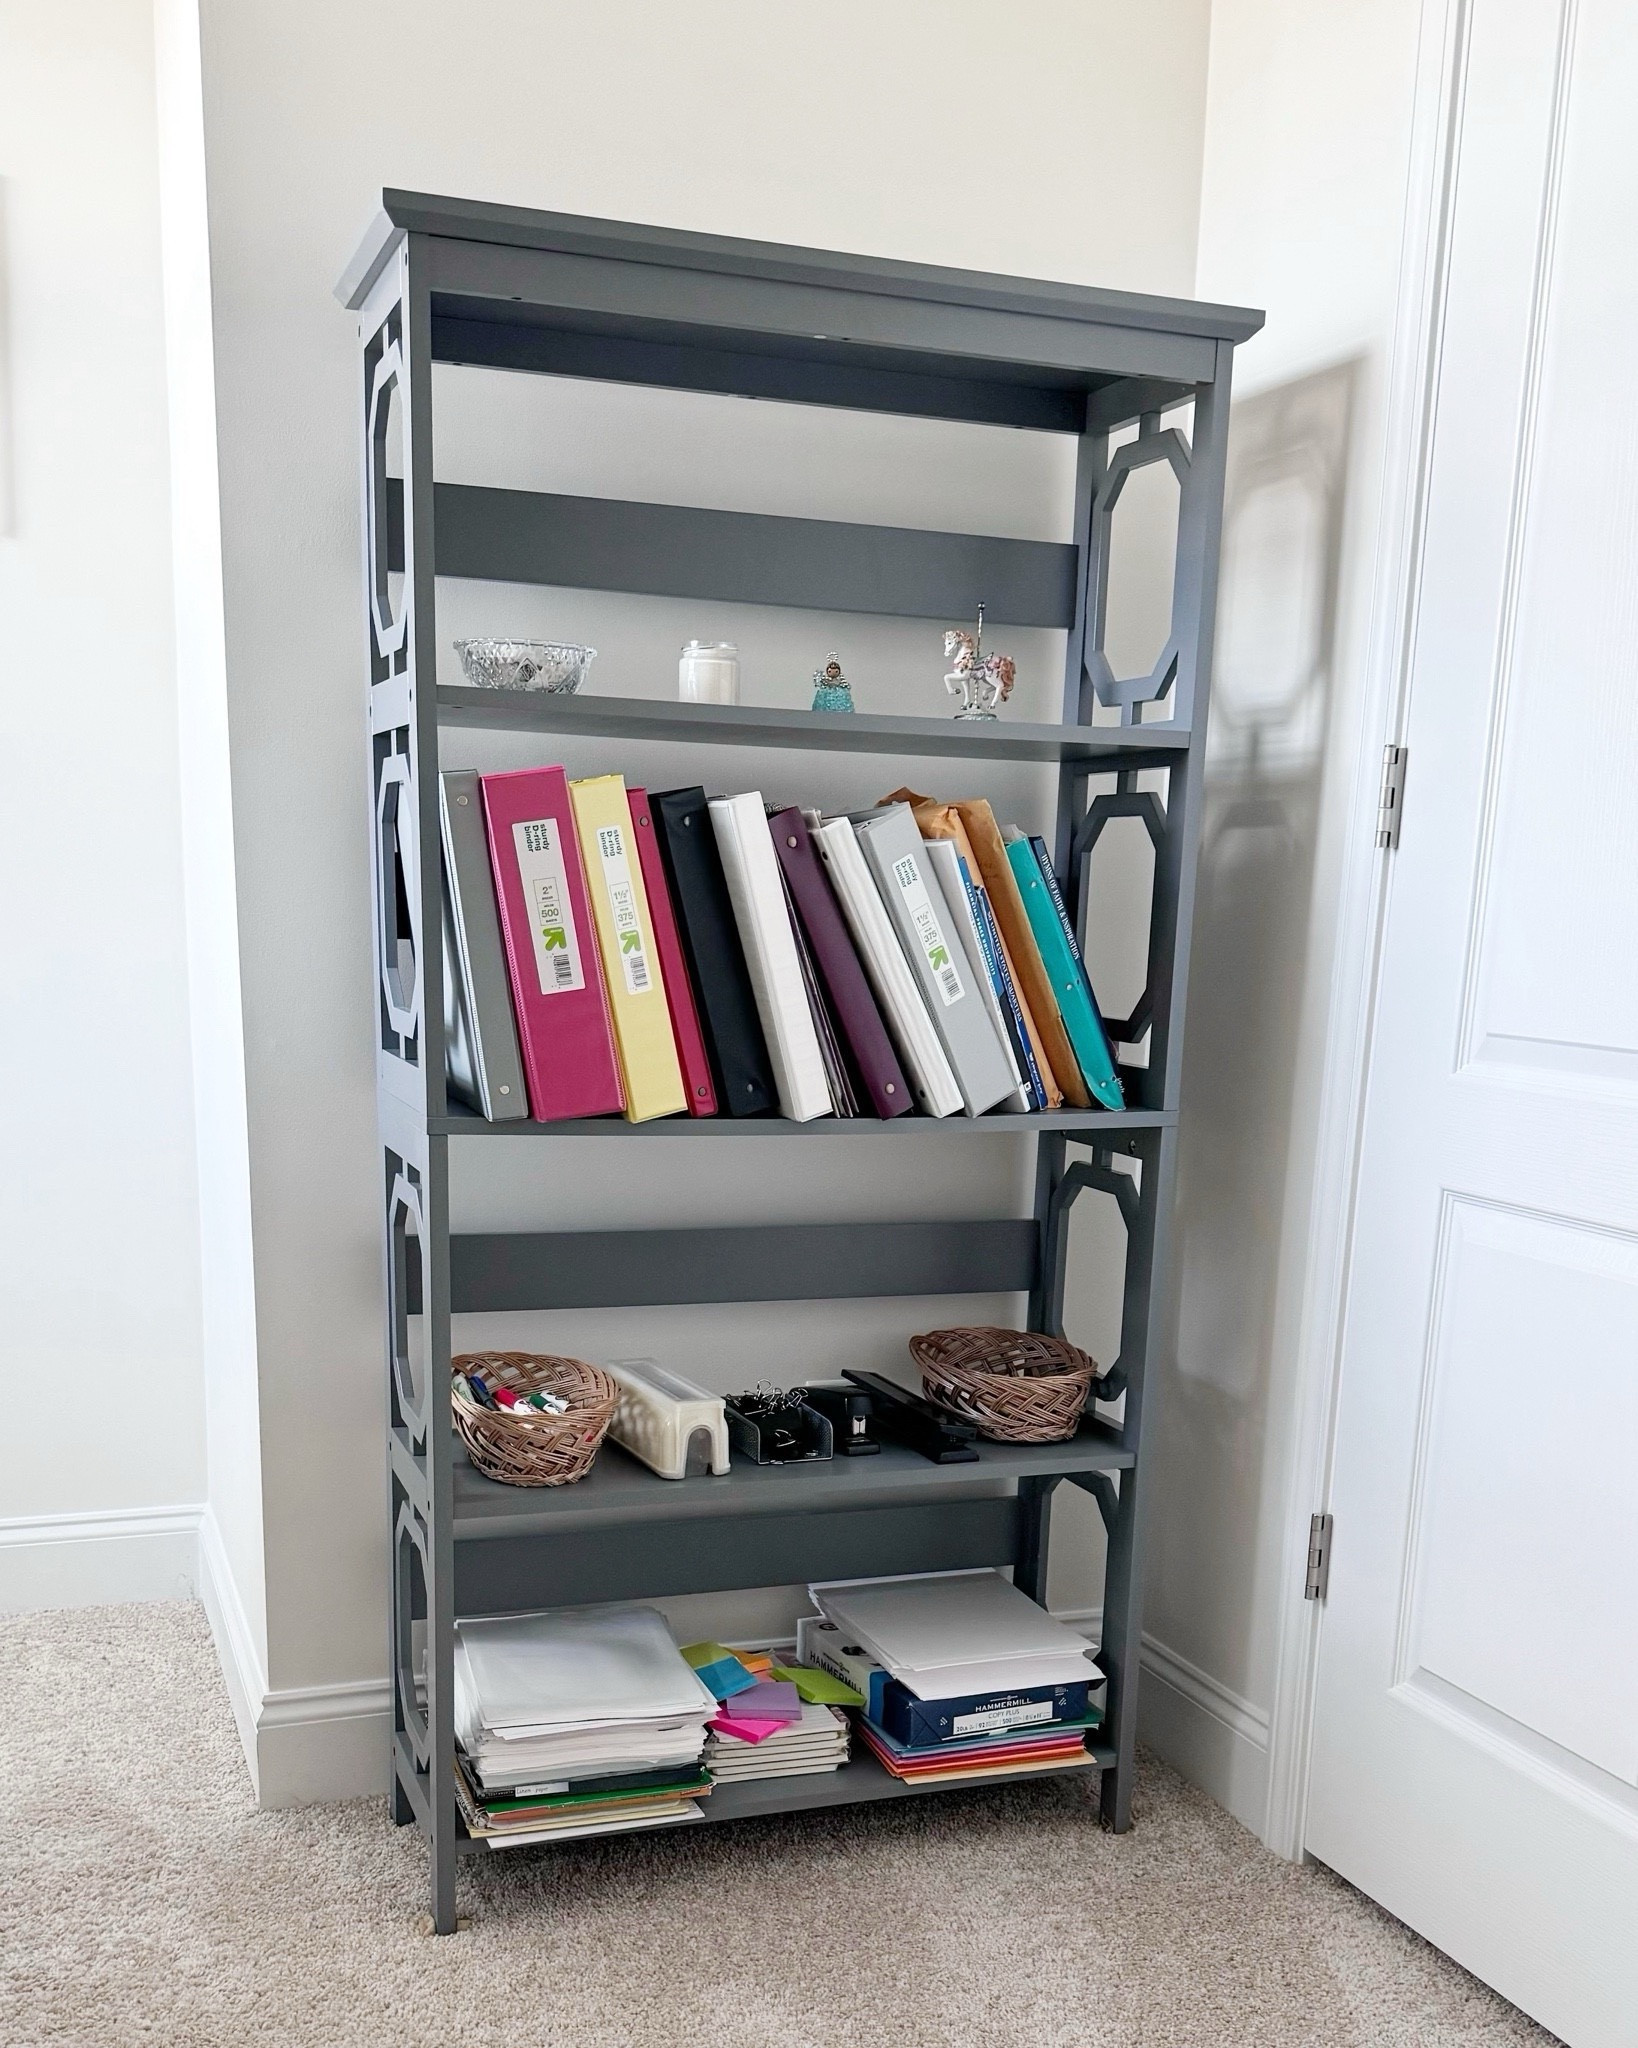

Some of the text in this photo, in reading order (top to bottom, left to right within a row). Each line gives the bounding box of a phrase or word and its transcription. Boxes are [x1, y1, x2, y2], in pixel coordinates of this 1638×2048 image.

[524, 826, 533, 852] binder
[532, 825, 541, 851] D-ring
[540, 824, 549, 850] sturdy
[600, 832, 608, 857] binder
[607, 831, 615, 856] D-ring
[613, 829, 622, 855] sturdy
[895, 865, 906, 888] binder
[900, 861, 912, 886] D-ring
[906, 858, 918, 882] sturdy
[541, 908, 559, 918] 500
[617, 911, 634, 922] 375
[1041, 853, 1081, 960] HYMNS OF FAITH & INSPIRATION
[923, 931, 938, 943] 375
[965, 881, 996, 976] FINANCIAL PEACE UNIVERSITY
[990, 922, 1003, 953] UNITED
[1000, 954, 1010, 981] STATES
[1007, 979, 1023, 1023] QUARTERS
[975, 1698, 1033, 1713] HAMMERMILL
[988, 1711, 1004, 1719] COPY
